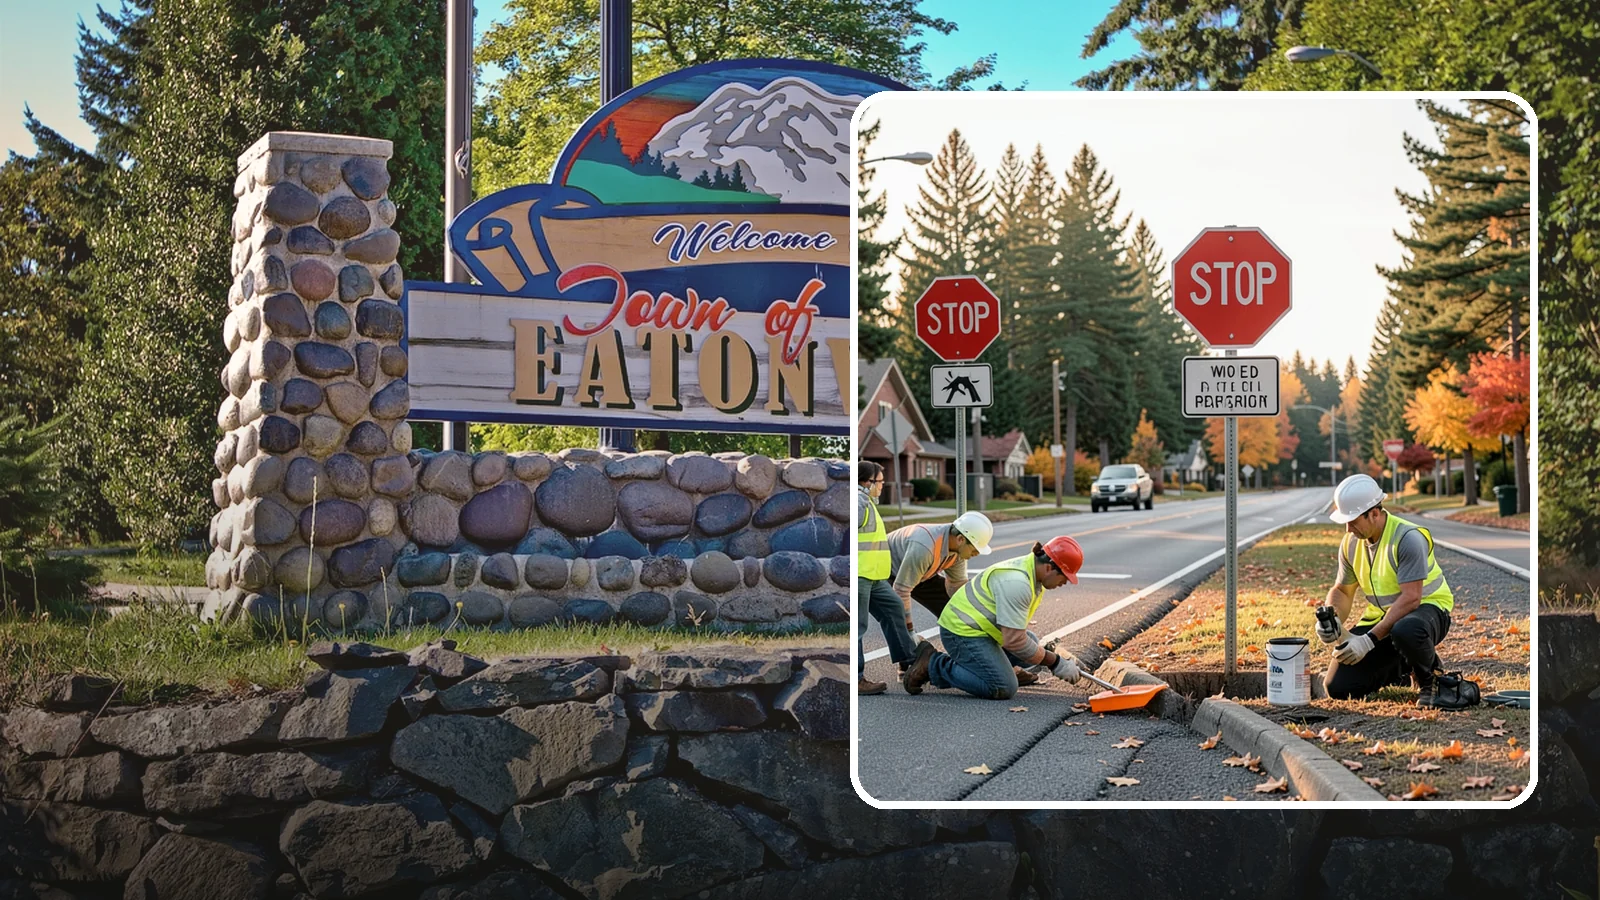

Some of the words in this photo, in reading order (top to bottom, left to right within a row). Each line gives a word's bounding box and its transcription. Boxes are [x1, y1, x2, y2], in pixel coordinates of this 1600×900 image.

[654, 220, 836, 263] Welcome
[1190, 261, 1277, 305] STOP
[557, 263, 737, 336] Town
[765, 278, 825, 365] of
[927, 301, 990, 335] STOP
